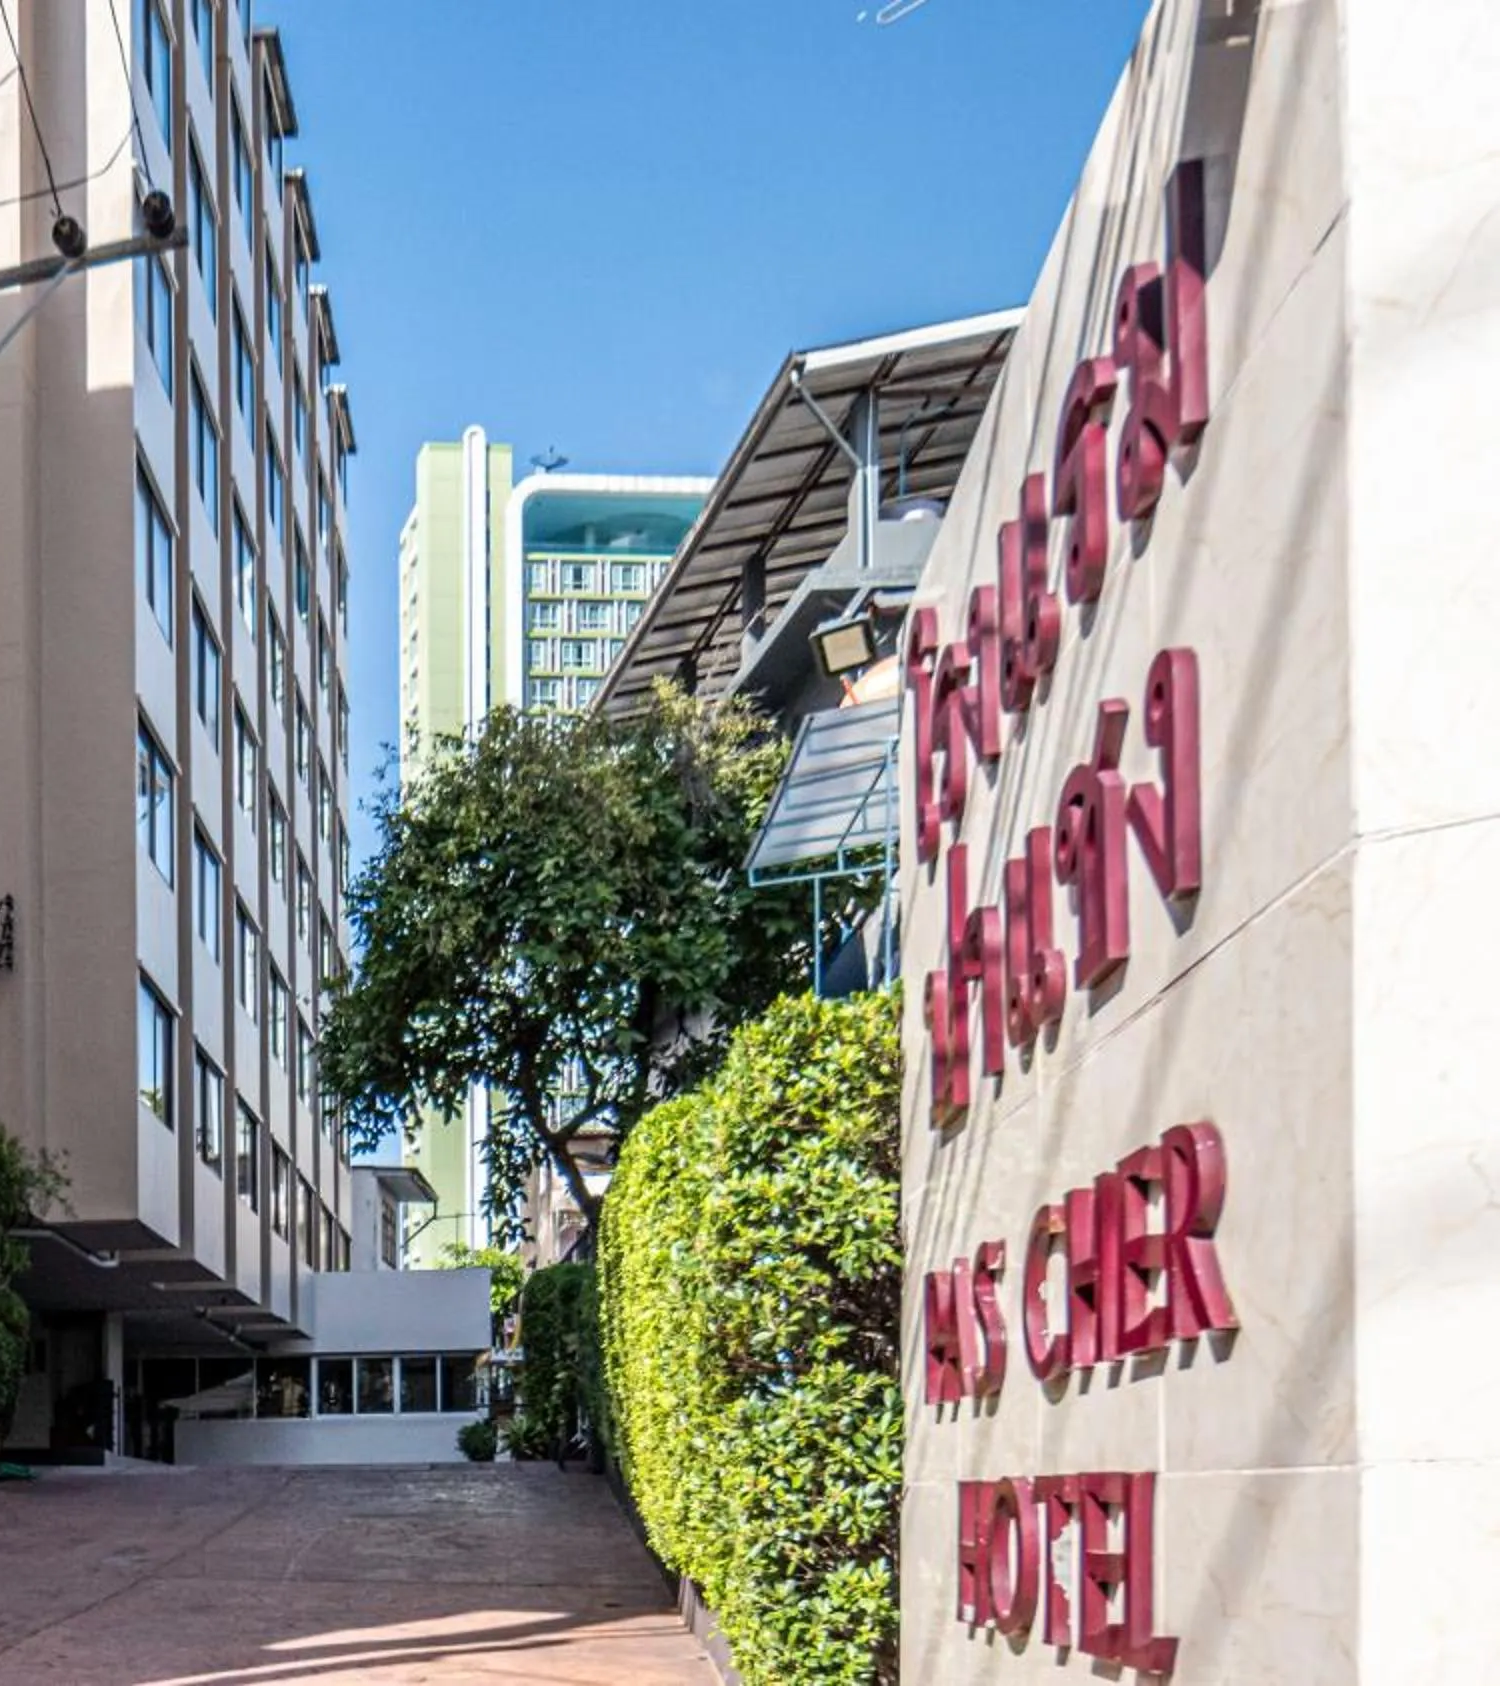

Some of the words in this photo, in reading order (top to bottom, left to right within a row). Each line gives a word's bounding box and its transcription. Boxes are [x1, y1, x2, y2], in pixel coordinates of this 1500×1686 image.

[905, 159, 1209, 863] โรงแรม
[1023, 1120, 1240, 1382] CHER
[957, 1471, 1179, 1675] HOTEL
